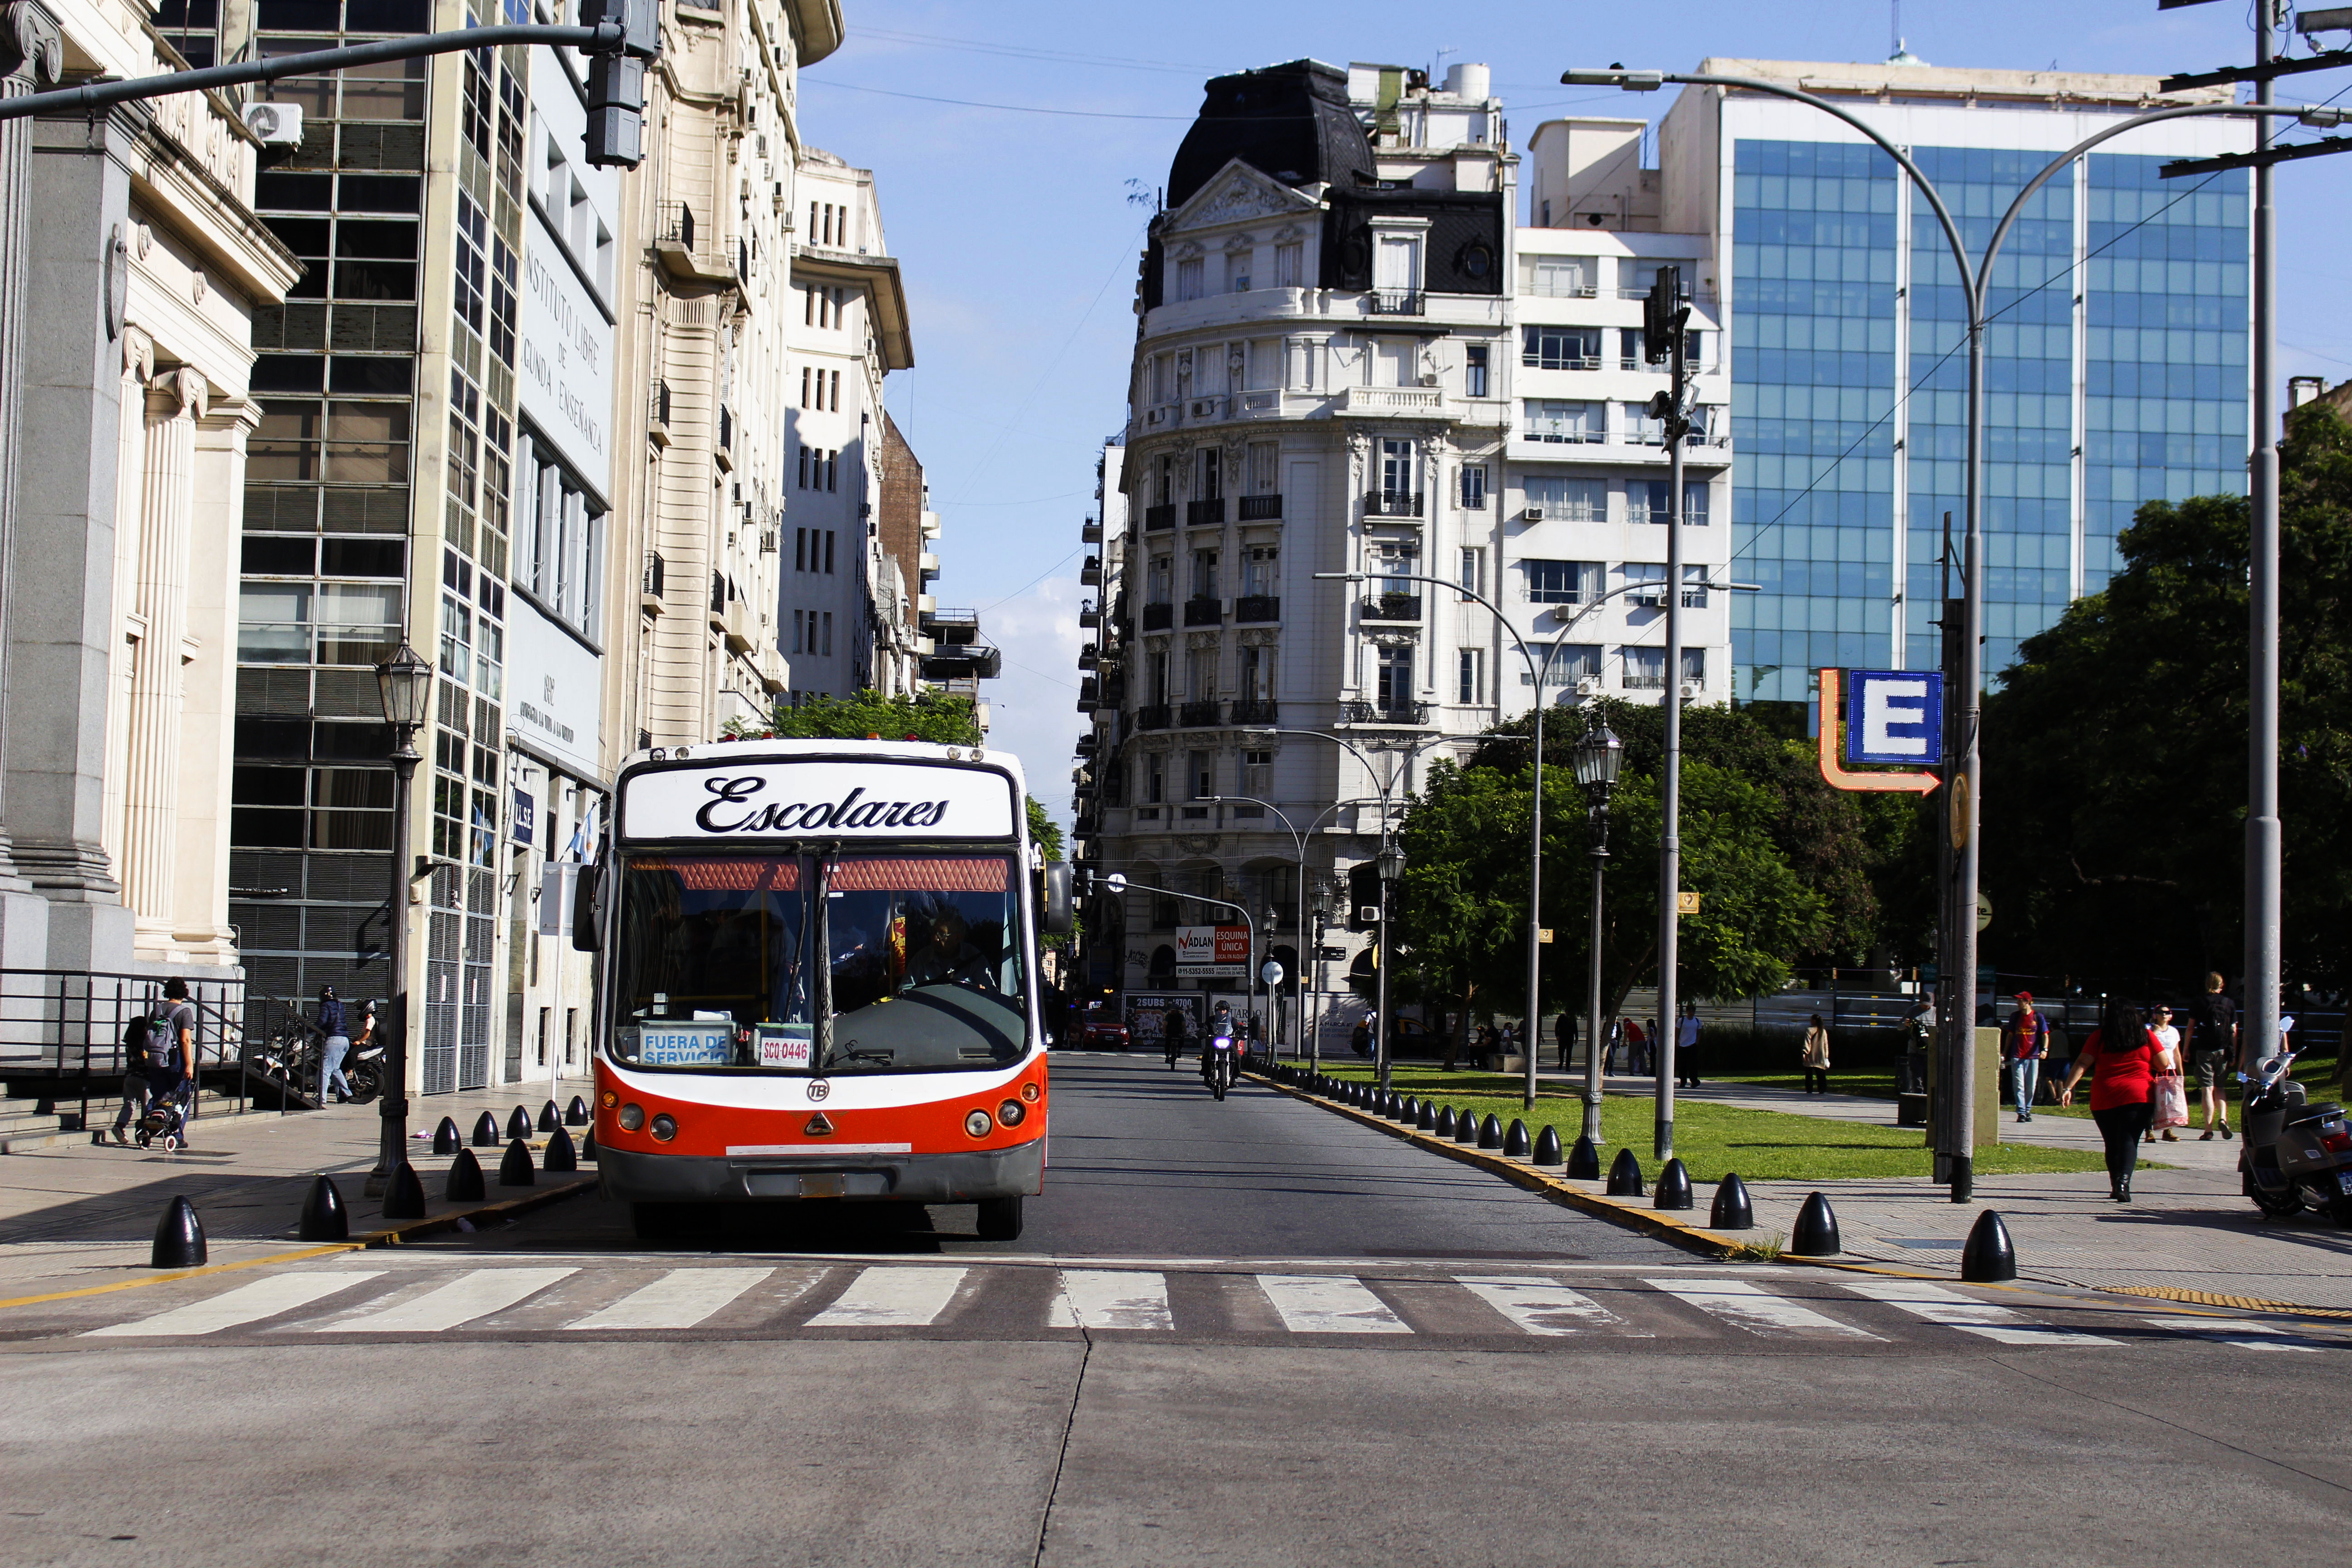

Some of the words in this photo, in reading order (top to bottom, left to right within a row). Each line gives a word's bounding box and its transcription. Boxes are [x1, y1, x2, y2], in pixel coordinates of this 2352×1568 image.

[524, 242, 572, 337] INSTITUTO
[575, 315, 599, 376] LIBRE
[558, 342, 567, 369] DE
[521, 332, 551, 397] GUNDA
[559, 380, 602, 456] ENSEÑANZA
[1862, 679, 1927, 755] E
[696, 776, 949, 833] Escolares
[1178, 930, 1214, 950] NADLAN
[1216, 931, 1248, 941] ESQUINA
[1221, 941, 1243, 951] ÚNICA
[645, 1035, 700, 1049] FUERA
[706, 1035, 727, 1049] DE
[764, 1042, 808, 1061] SCQ-0446
[644, 1051, 729, 1064] SERVICIO
[808, 1084, 828, 1097] TB
